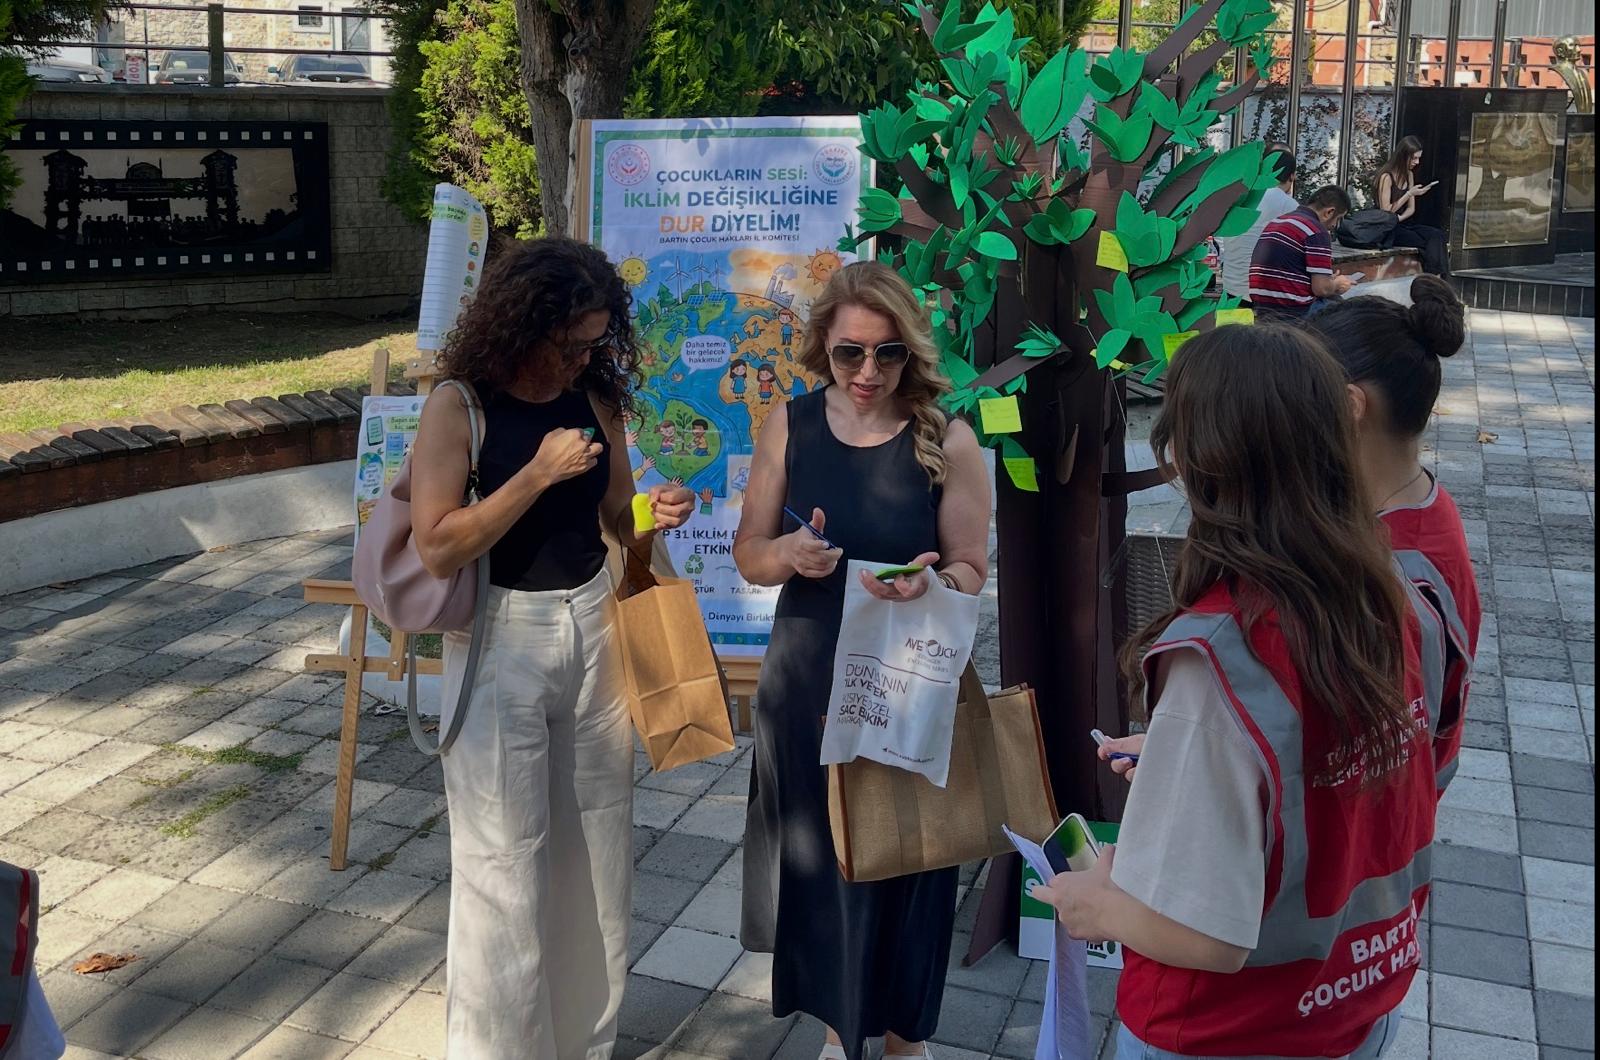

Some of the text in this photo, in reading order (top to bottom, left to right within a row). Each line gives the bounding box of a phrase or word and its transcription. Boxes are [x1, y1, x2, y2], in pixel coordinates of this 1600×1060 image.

[656, 169, 762, 184] ÇOCUKLARIN
[767, 166, 808, 181] SESİ:
[623, 184, 838, 210] İKLİM DEĞİŞİKLİĞİNE
[659, 210, 800, 233] DUR DİYELİM!
[690, 236, 717, 245] ÇOCUK
[718, 235, 752, 243] HAKLARI
[685, 340, 727, 349] Daha temiz
[686, 346, 726, 357] bir gelecek
[688, 355, 723, 364] hakkımız!
[674, 530, 689, 539] 31
[692, 527, 727, 540] İKLİM
[694, 541, 731, 555] ETKİN
[694, 586, 715, 595] ŞTÜR
[746, 612, 776, 622] Birlikt
[1297, 959, 1386, 1018] ÇOCUK
